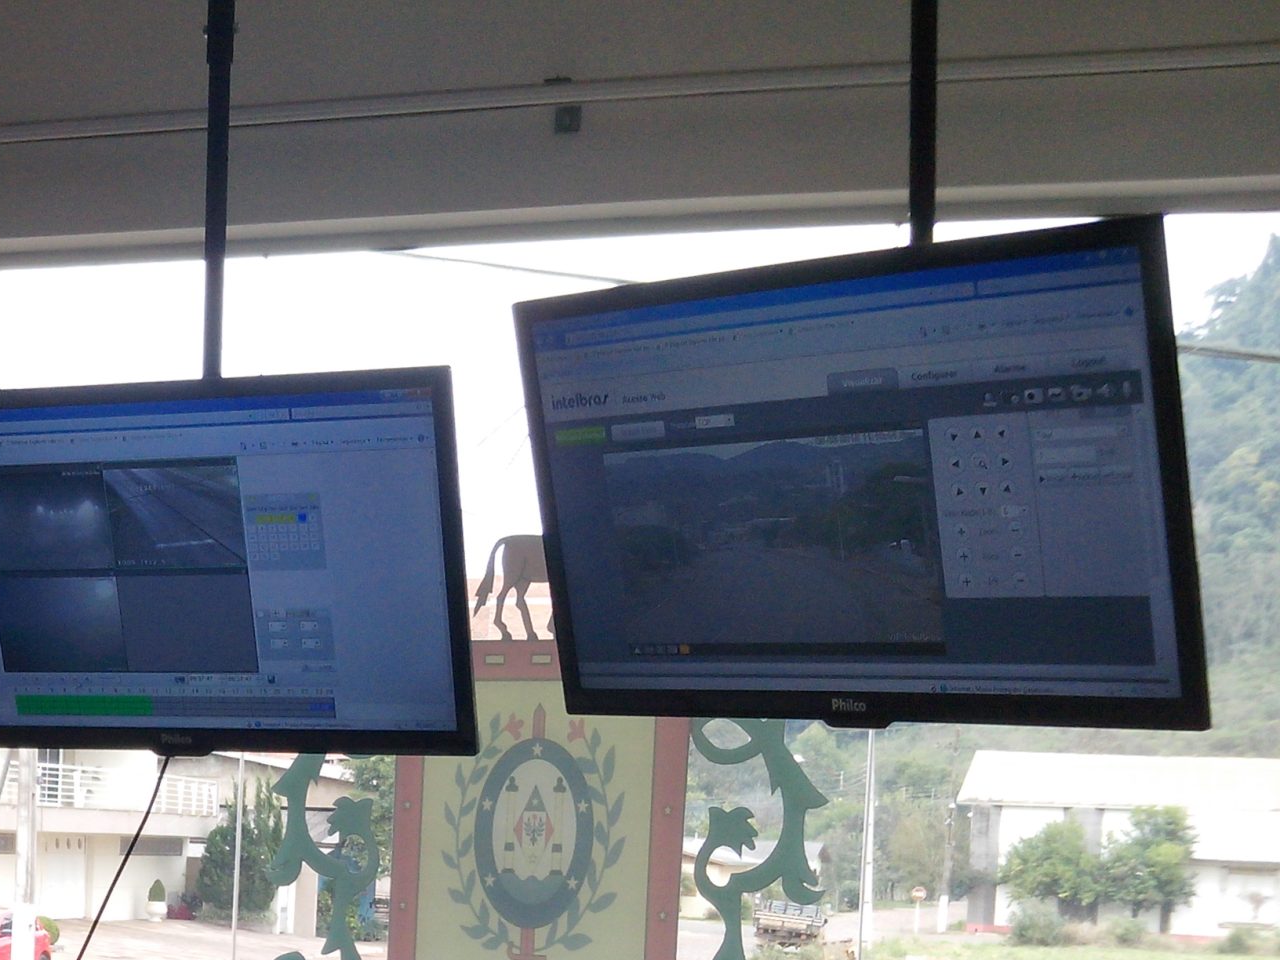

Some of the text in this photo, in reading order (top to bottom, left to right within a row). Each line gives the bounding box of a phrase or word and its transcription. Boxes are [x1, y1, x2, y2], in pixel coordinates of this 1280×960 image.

[551, 393, 609, 411] intelbras
[831, 698, 867, 713] Philco
[160, 733, 192, 745] Philco
